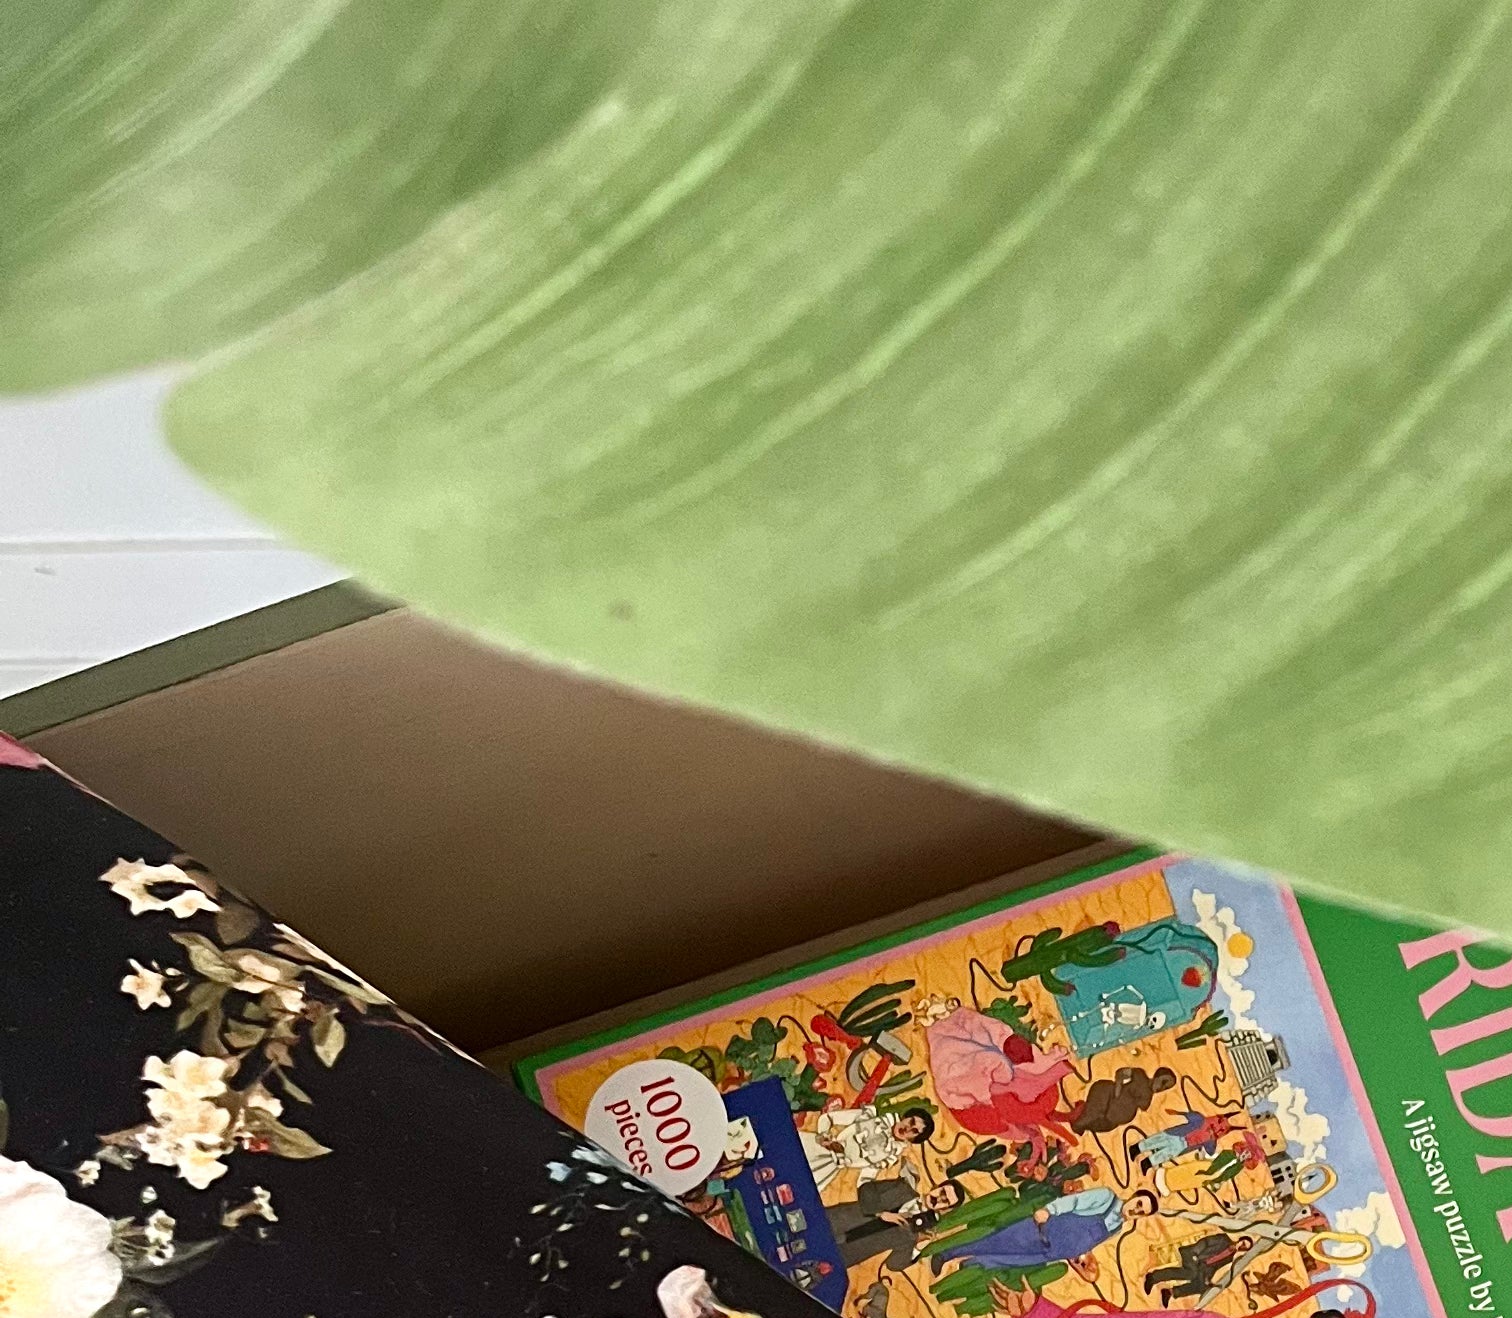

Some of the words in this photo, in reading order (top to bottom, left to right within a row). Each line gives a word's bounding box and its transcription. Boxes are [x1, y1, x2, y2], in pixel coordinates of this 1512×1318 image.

[604, 1099, 652, 1176] pieces
[639, 1076, 701, 1172] 1000
[1401, 1100, 1425, 1116] A
[1404, 1116, 1453, 1195] jigsaw
[1433, 1200, 1483, 1279] puzzle
[1468, 1280, 1495, 1311] by
